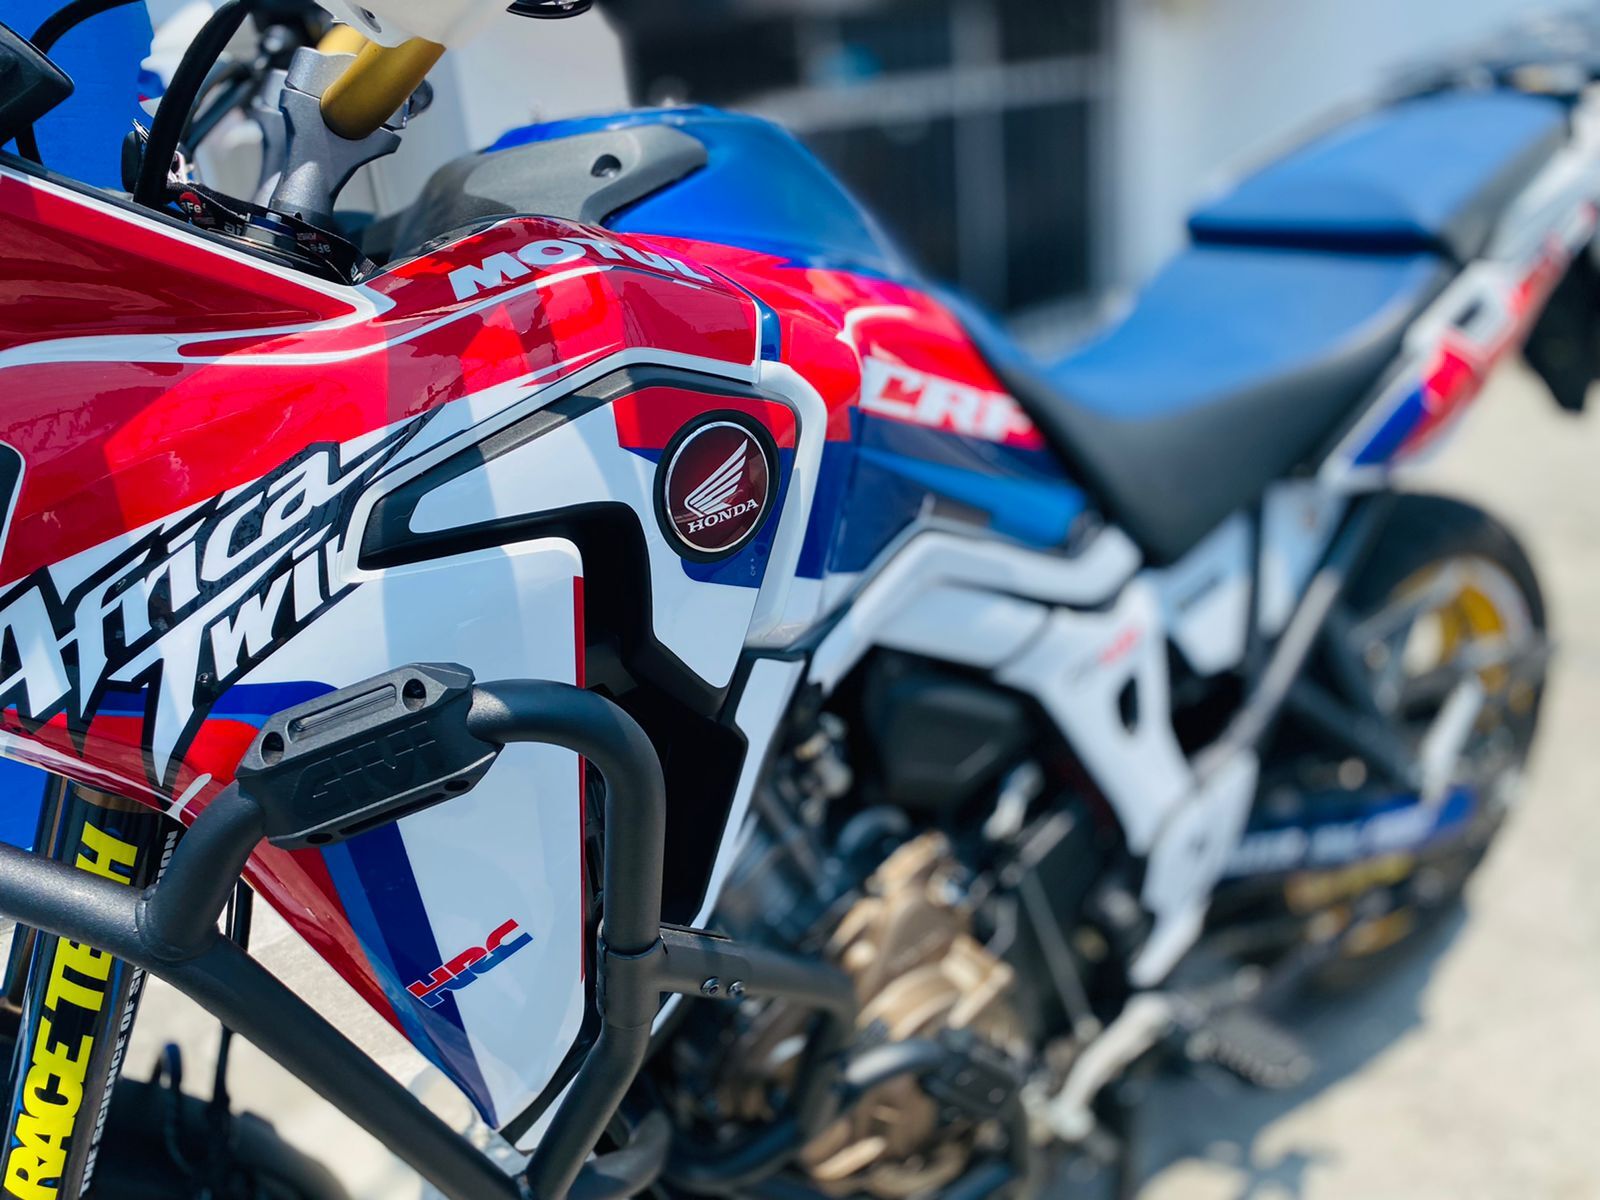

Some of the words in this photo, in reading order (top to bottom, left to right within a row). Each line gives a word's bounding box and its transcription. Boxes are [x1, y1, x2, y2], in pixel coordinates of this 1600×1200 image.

[447, 237, 714, 302] MOTUL
[0, 440, 390, 720] Africa
[688, 498, 759, 534] HONDA
[44, 820, 138, 1012] TEH
[405, 918, 534, 1009] HRC
[3, 1014, 94, 1200] RACE
[78, 1144, 100, 1198] THE
[92, 1029, 129, 1144] SCIENCE
[119, 997, 137, 1030] OF
